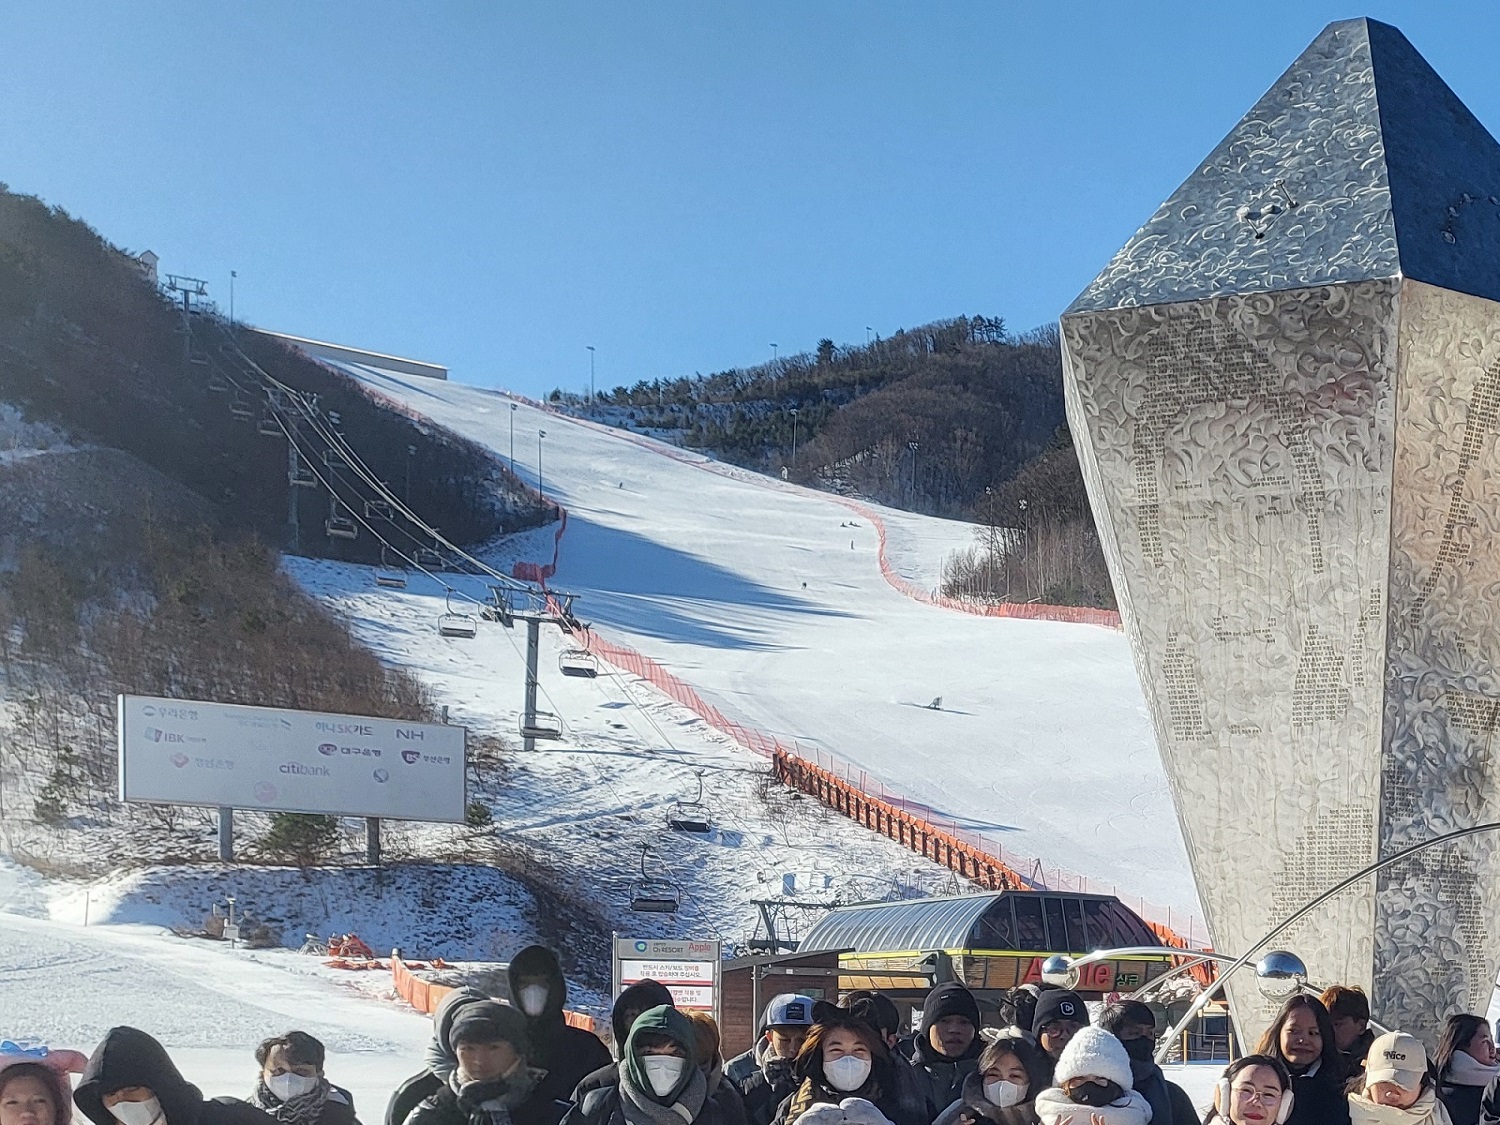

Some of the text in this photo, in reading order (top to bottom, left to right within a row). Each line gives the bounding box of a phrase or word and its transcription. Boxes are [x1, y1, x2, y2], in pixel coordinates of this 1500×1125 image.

[158, 707, 199, 721] 우리은행
[164, 732, 185, 743] IBK
[396, 728, 424, 741] NH
[278, 763, 331, 777] citibank
[688, 942, 712, 953] Apple
[1022, 956, 1111, 987] Ale
[1116, 973, 1139, 986] 상급
[1383, 1050, 1406, 1061] Nice
